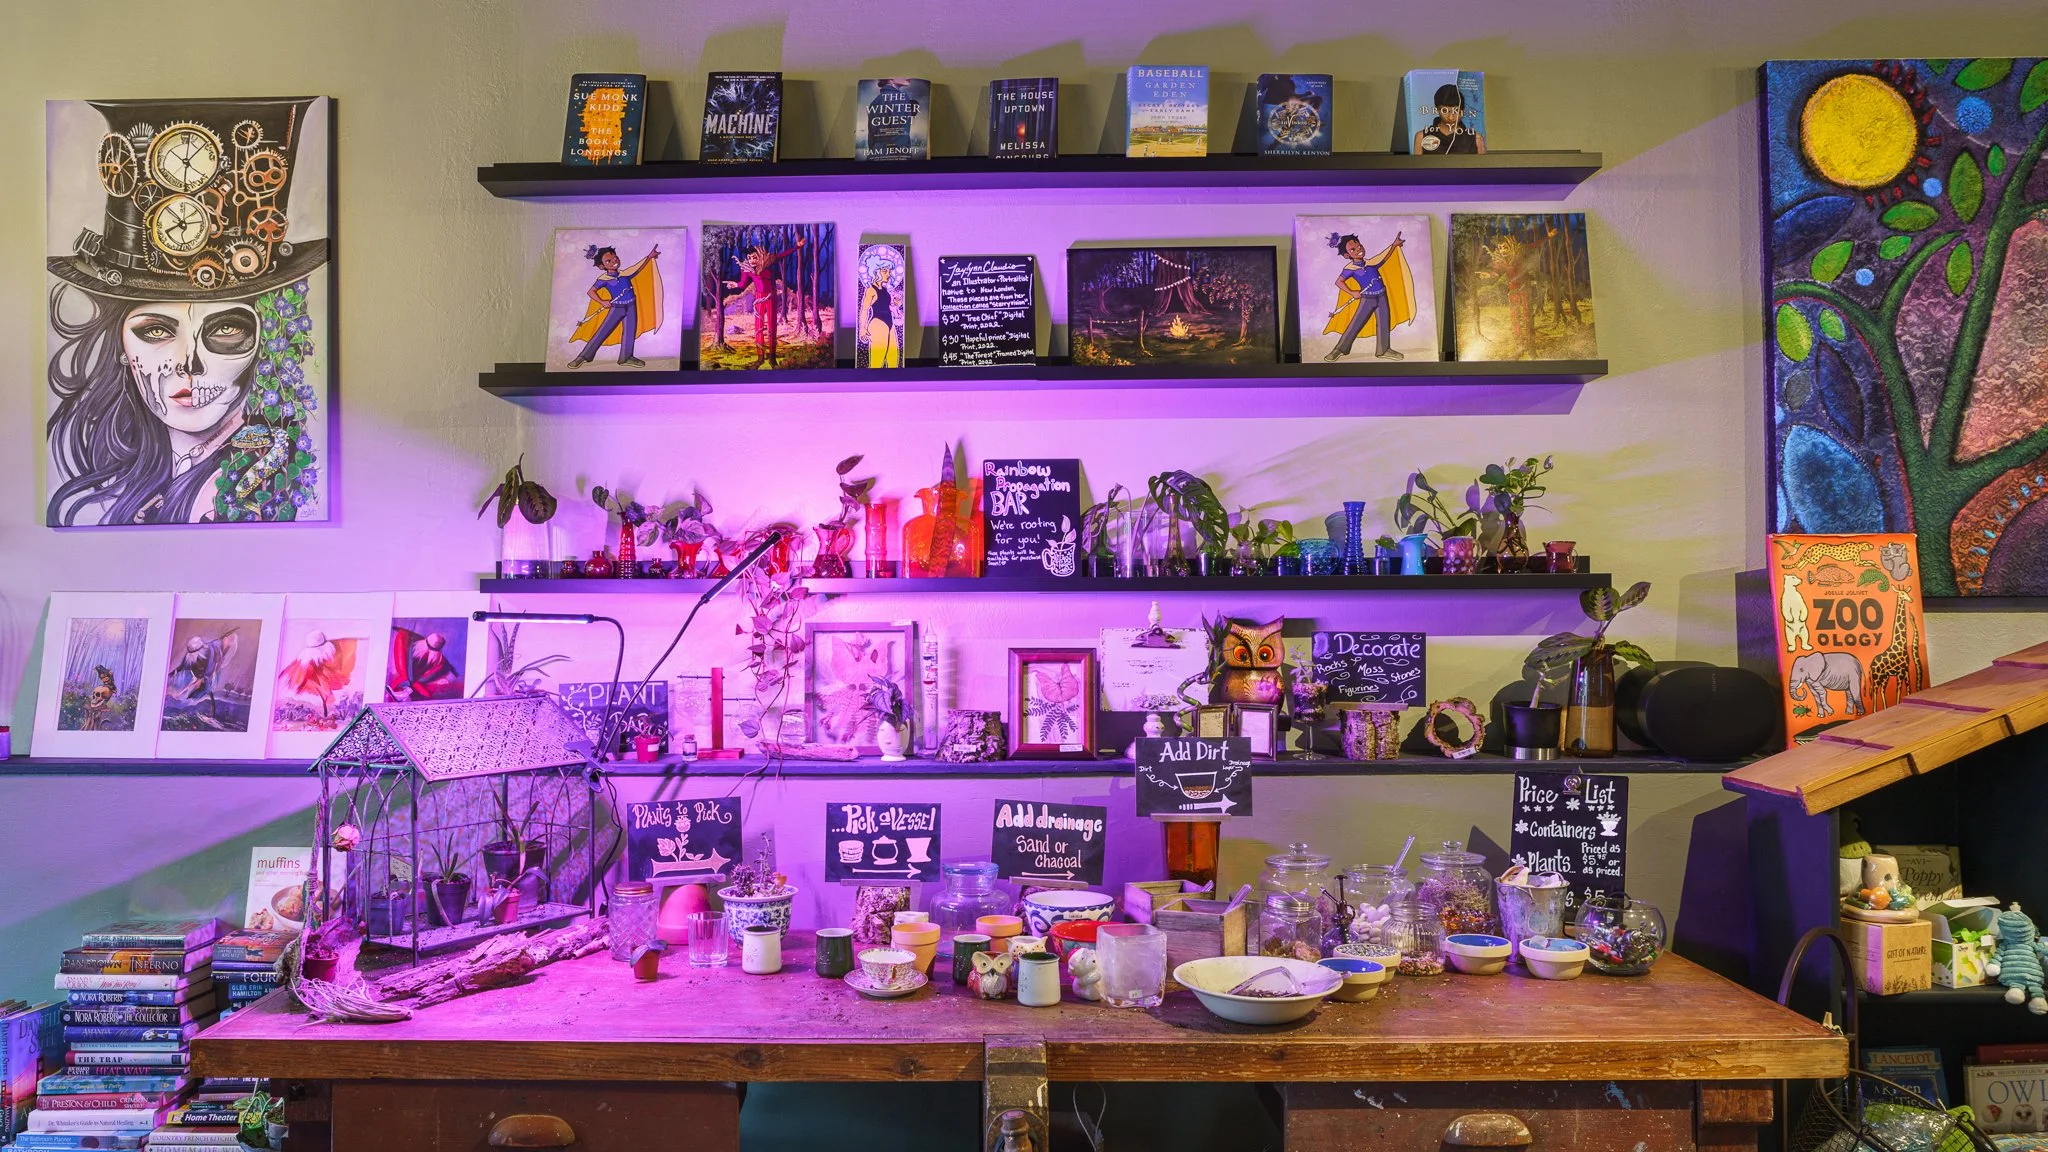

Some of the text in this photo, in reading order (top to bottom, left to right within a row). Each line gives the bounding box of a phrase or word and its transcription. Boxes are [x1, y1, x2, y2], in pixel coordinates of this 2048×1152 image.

[1138, 69, 1204, 78] BASEBALL
[573, 92, 638, 102] SUE MONK
[881, 92, 906, 102] THE
[997, 91, 1055, 101] THE HOUSE
[589, 103, 620, 112] KIDD
[866, 103, 921, 114] WINTER
[1004, 104, 1045, 113] UPTOWN
[1419, 105, 1477, 118] BROKEN
[705, 113, 773, 135] MACHINE
[871, 115, 916, 127] GUEST
[591, 127, 612, 135] THE
[1424, 124, 1440, 134] for
[578, 138, 609, 146] BOOK
[1000, 141, 1046, 150] MELISSA
[570, 148, 628, 157] LONGINGS
[863, 147, 919, 156] PAM JENOFF
[982, 261, 1022, 272] Claudio
[980, 286, 993, 294] New
[942, 334, 959, 346] $30
[984, 460, 1051, 477] Rainbow
[996, 476, 1071, 499] Propagation
[990, 491, 1029, 516] BAR
[990, 517, 1057, 533] We're rooting
[995, 533, 1040, 549] for you!
[1813, 597, 1884, 631] ZOO
[1333, 632, 1421, 658] Decorate
[1817, 632, 1883, 647] OLOGY
[1315, 660, 1348, 674] Rocks
[1357, 663, 1384, 676] Moss
[1391, 667, 1421, 682] Stones
[588, 682, 664, 707] PLANT
[1338, 684, 1379, 697] Figurines
[1159, 740, 1229, 763] Add Dirt
[1518, 775, 1616, 804] Price List
[632, 800, 732, 829] Plants to Pick
[879, 811, 891, 825] a
[996, 803, 1103, 841] Add drainage
[1529, 819, 1597, 840] Containers
[1016, 834, 1069, 854] Sand or
[1581, 841, 1621, 854] Priced as
[257, 856, 301, 869] muffins
[1034, 849, 1082, 868] Chacoal
[1582, 866, 1624, 878] as priced.
[1902, 867, 1944, 886] Poppy
[1886, 946, 1927, 959] GIFT OF NATURE
[63, 956, 179, 972] DAN BROWN INFERNO
[243, 972, 276, 983] FOUR
[79, 992, 123, 1003] NORA ROBERTS
[75, 1011, 168, 1024] NORA ROBERTS THE COLLECTOR
[1874, 1052, 1932, 1065] LANCELOT
[96, 1066, 151, 1076] HEAT WAVE
[51, 1099, 84, 1108] PRESTON
[91, 1099, 117, 1108] CHILD
[184, 1113, 238, 1121] Home Theater
